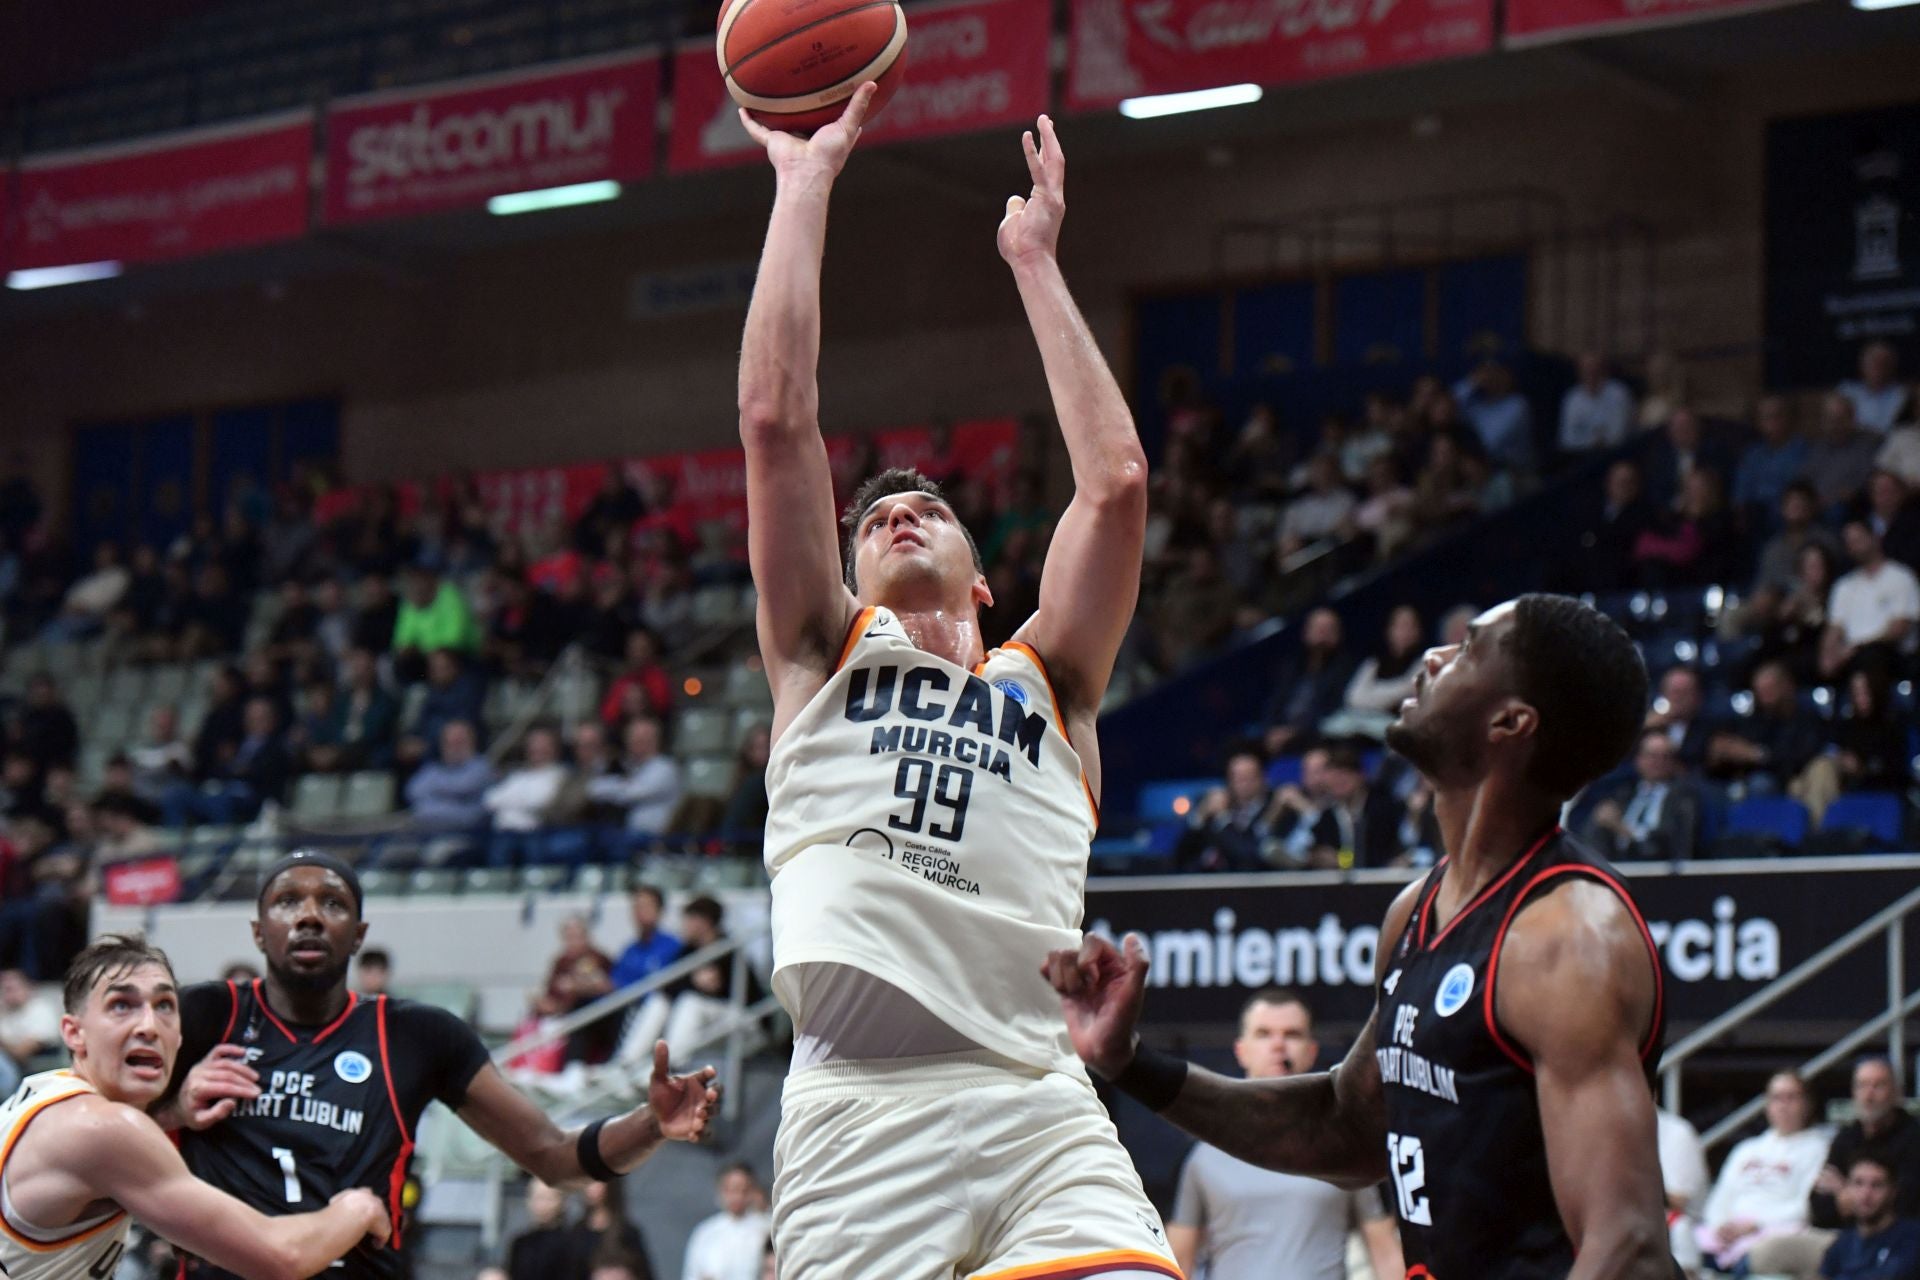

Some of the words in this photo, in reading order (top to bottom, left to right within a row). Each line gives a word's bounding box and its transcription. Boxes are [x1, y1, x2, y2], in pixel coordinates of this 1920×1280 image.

[844, 665, 1047, 770] UCAM
[870, 725, 1012, 784] MURCIA
[888, 757, 974, 842] 99
[902, 851, 960, 875] REGIÓN
[904, 841, 927, 851] Costa
[923, 868, 980, 896] MURCIA
[1090, 907, 1381, 988] miento
[232, 1092, 287, 1118] ART
[289, 1096, 364, 1136] LUBLIN
[272, 1146, 302, 1203] 1
[1387, 1131, 1432, 1227] 12
